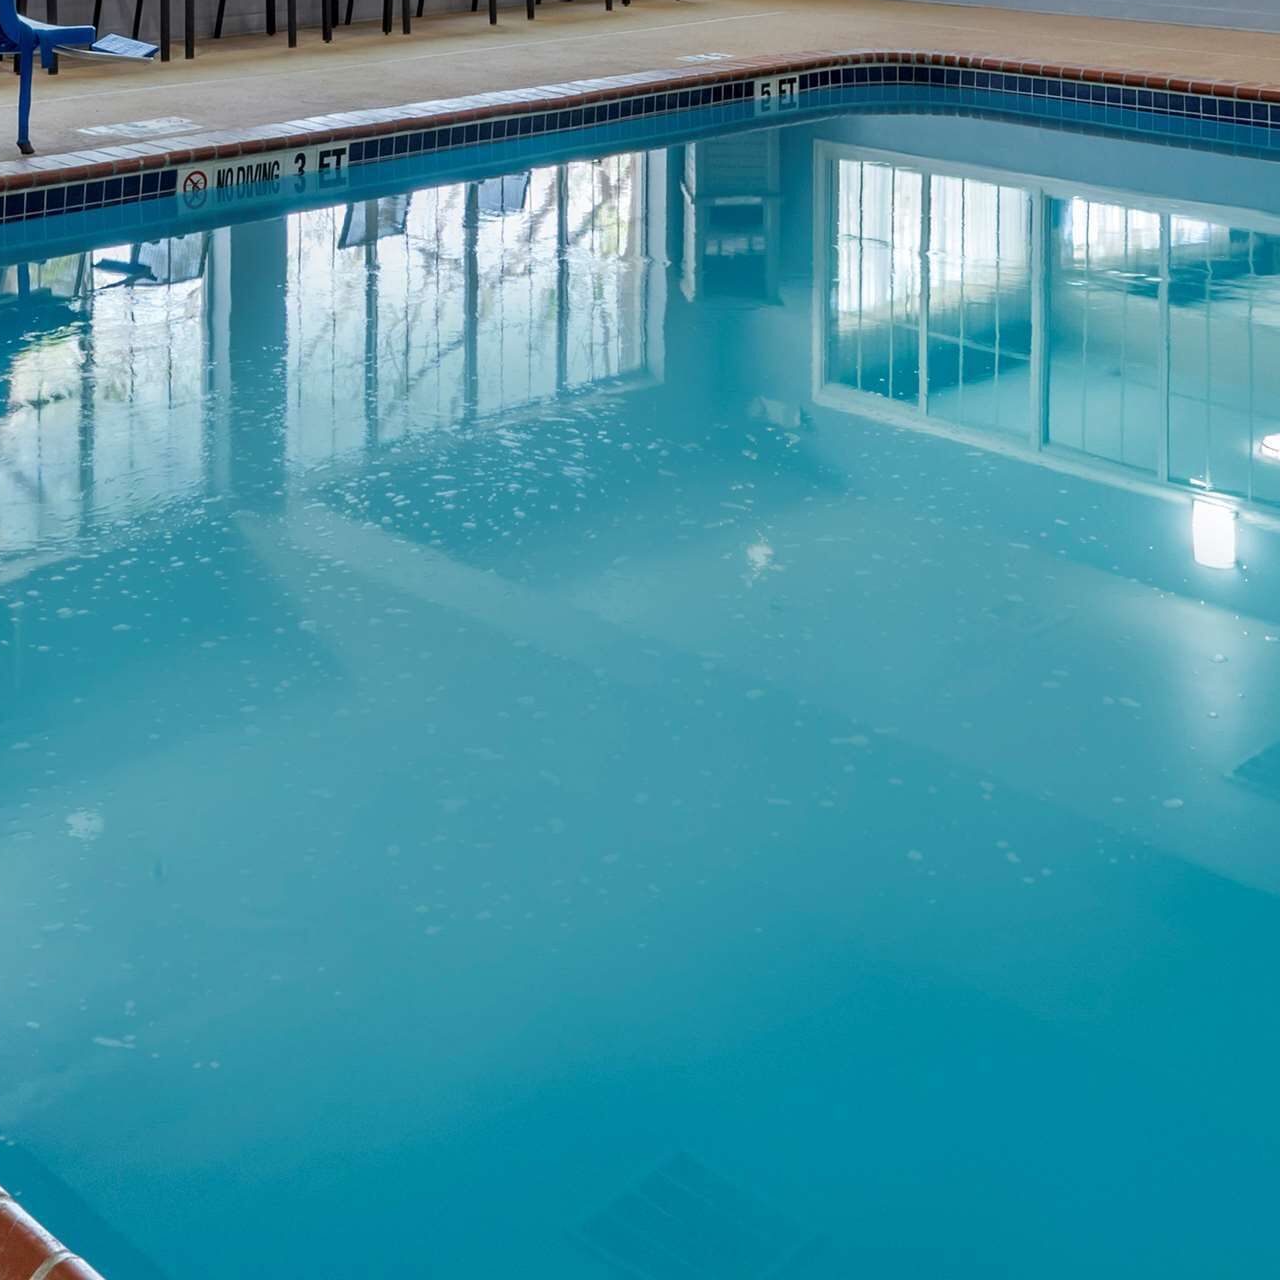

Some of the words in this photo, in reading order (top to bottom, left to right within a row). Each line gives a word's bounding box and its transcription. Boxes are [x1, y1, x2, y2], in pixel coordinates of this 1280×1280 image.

[236, 159, 281, 191] DIVING
[294, 152, 306, 177] 3
[319, 146, 347, 173] FT
